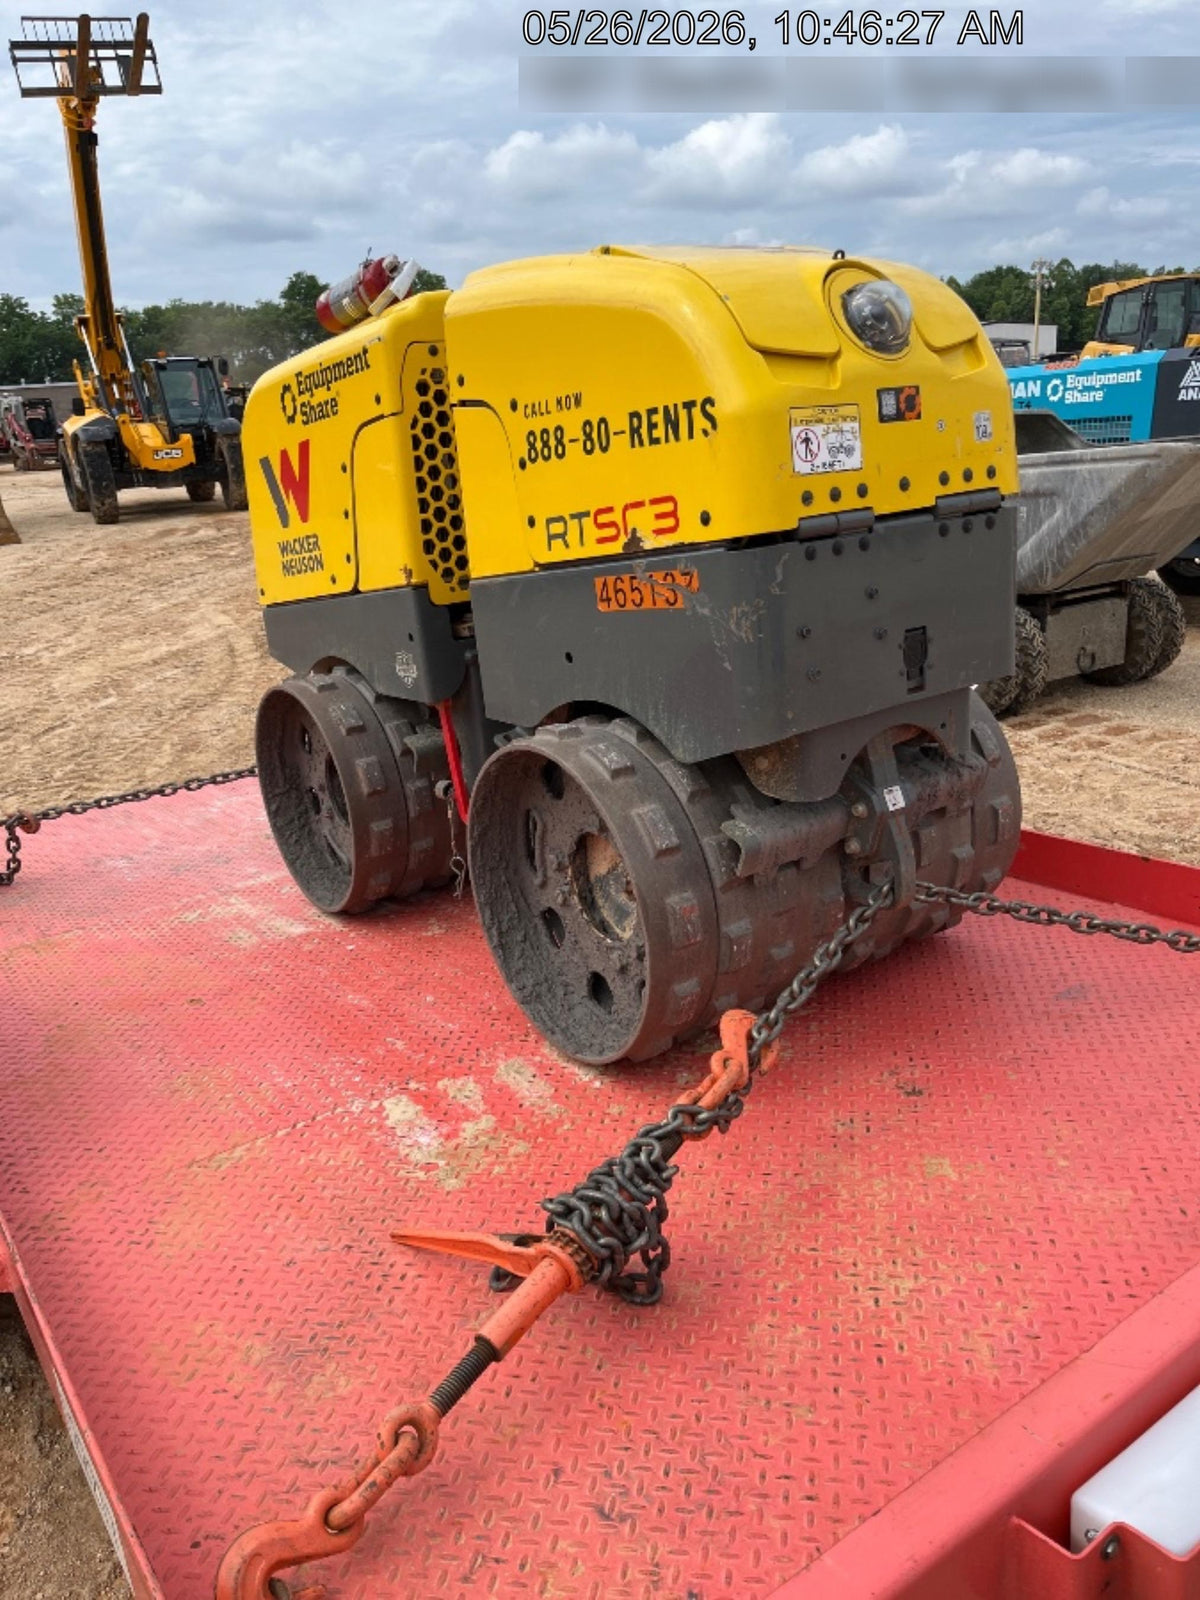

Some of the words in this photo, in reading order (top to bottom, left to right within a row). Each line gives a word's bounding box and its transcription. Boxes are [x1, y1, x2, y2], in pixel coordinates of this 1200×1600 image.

[295, 347, 371, 394] Equipment
[1066, 368, 1143, 389] Equipment
[523, 399, 552, 420] CALL
[555, 391, 583, 411] NOW
[1064, 389, 1104, 404] Share
[301, 397, 339, 426] Share
[526, 396, 717, 464] 888-80-RENTS
[153, 448, 183, 460] JCB
[277, 534, 321, 558] WACKER
[281, 554, 324, 577] NEUSON
